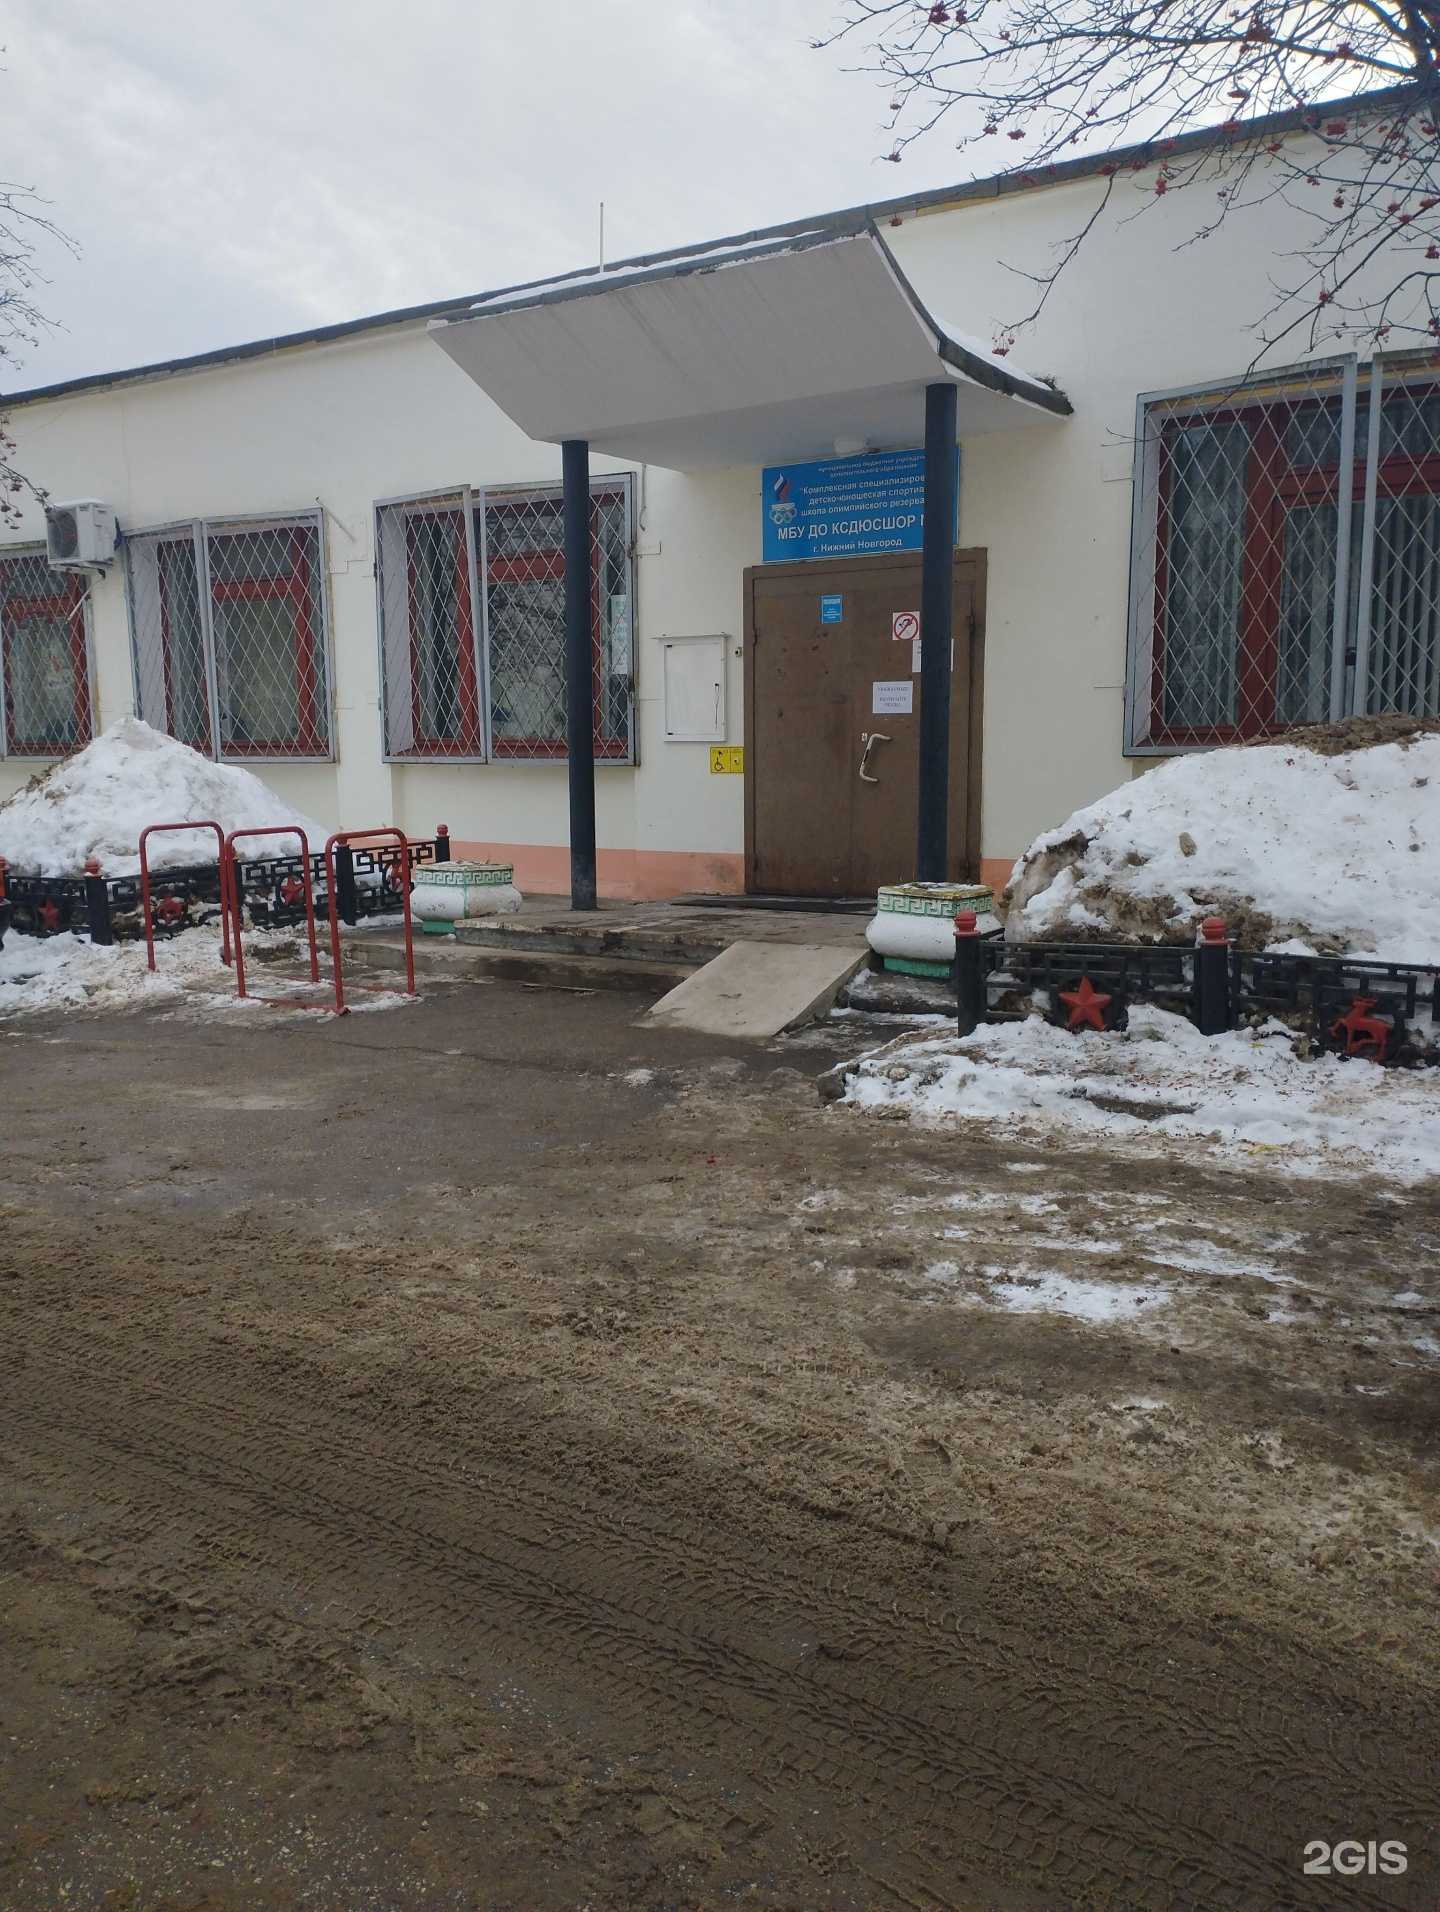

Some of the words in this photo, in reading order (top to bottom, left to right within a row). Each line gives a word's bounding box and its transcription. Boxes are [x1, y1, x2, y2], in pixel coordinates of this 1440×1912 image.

[799, 507, 827, 517] школа
[828, 500, 887, 514] олимпийского
[777, 526, 805, 540] МБУ
[808, 523, 828, 540] ДО
[831, 515, 916, 535] КСДЮСШОР
[820, 541, 856, 552] Нижний
[857, 538, 903, 550] Новгород
